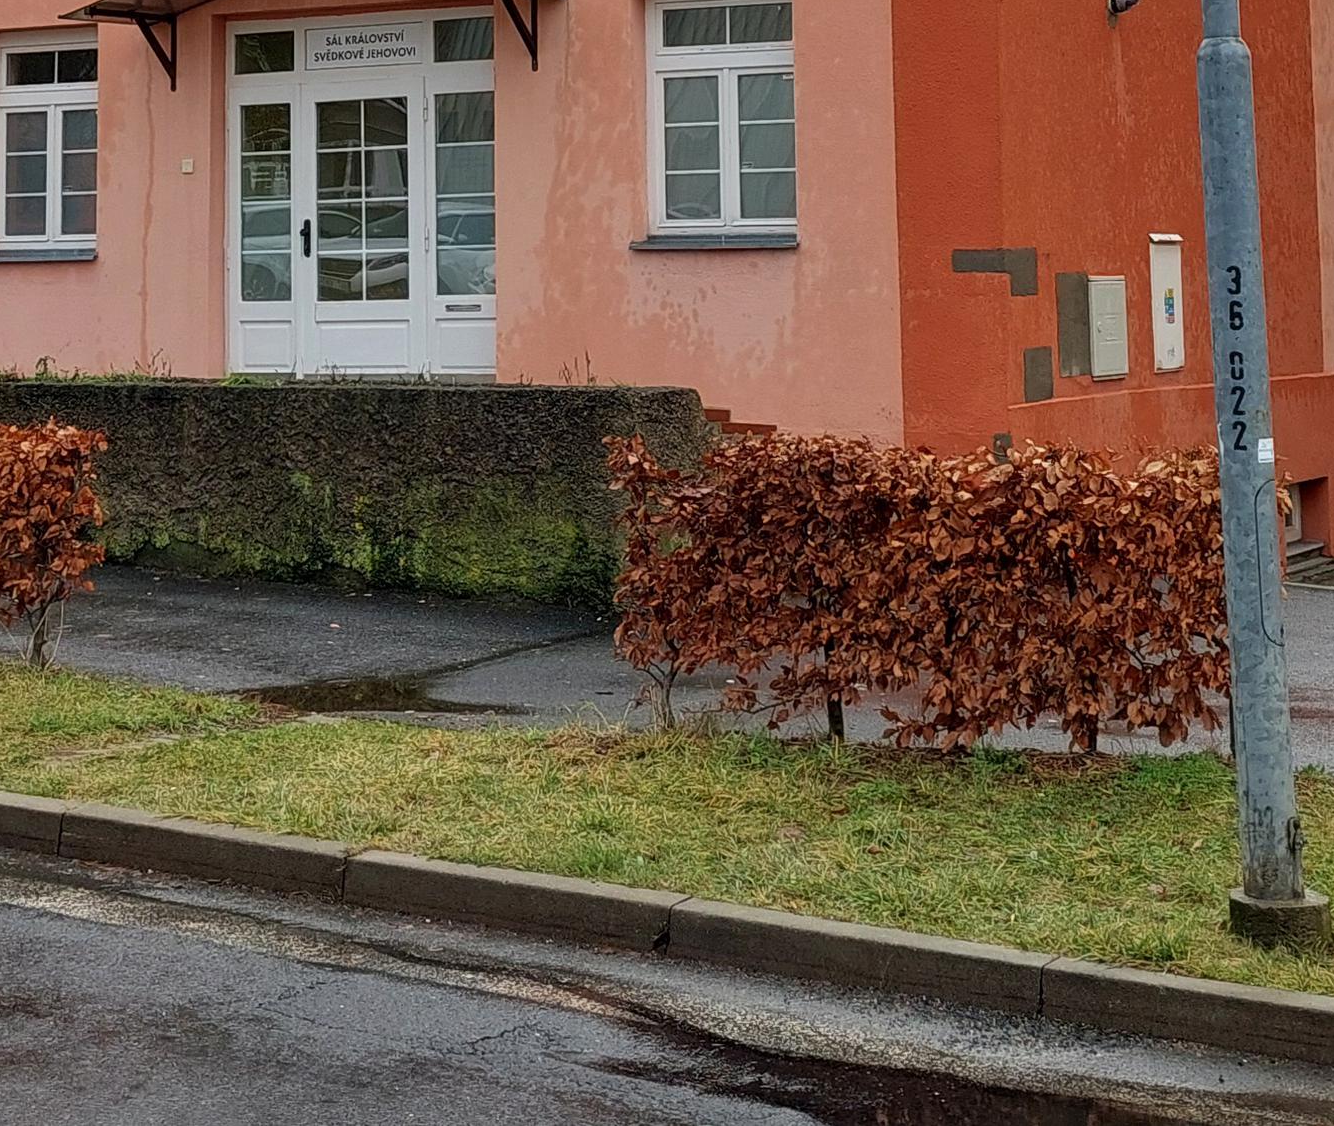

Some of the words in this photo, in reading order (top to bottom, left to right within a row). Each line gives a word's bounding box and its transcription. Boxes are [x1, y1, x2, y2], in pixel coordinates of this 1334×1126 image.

[325, 34, 343, 46] SÁL
[345, 29, 405, 45] KRÁLOVSTVÍ
[366, 46, 416, 59] JEHOVOVI
